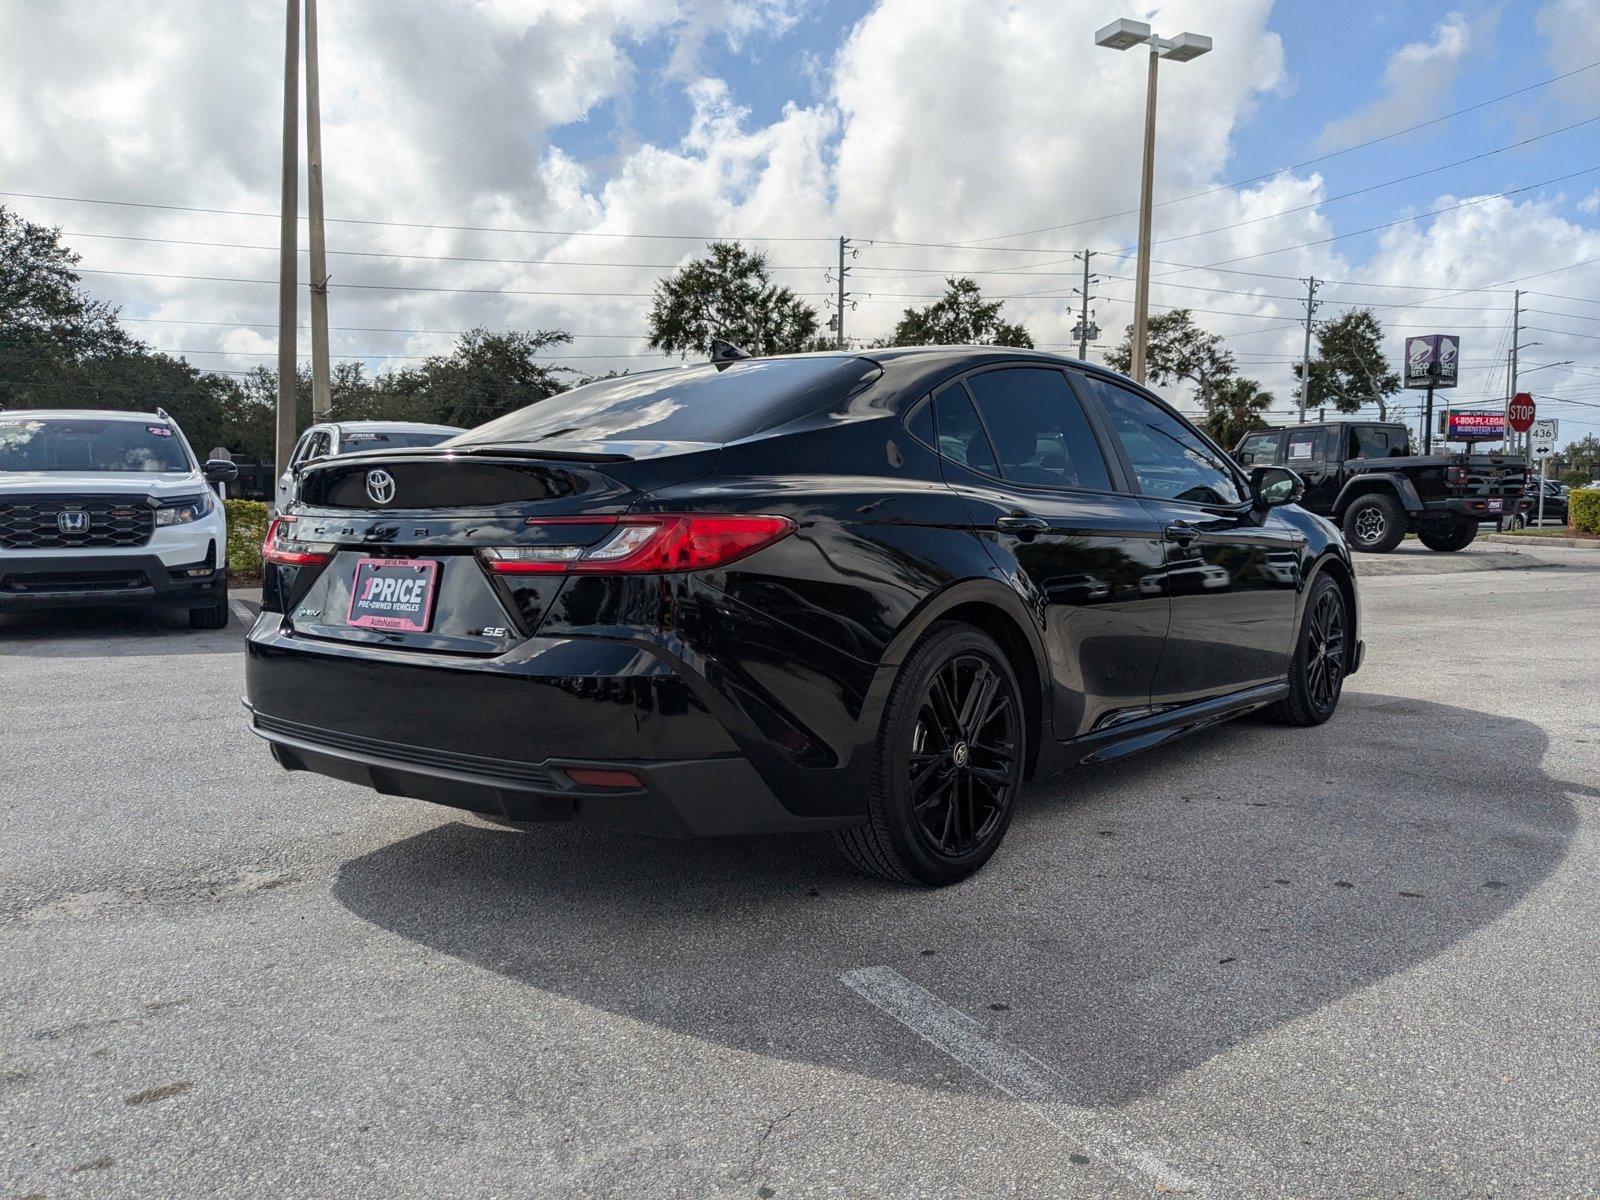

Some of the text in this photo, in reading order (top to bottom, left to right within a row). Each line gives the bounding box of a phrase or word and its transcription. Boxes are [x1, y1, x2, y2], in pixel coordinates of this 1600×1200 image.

[1410, 362, 1430, 370] TACO
[1441, 362, 1455, 370] TACO
[1411, 370, 1429, 378] BELL
[1441, 369, 1454, 377] BELL
[1510, 405, 1534, 420] STOP
[1455, 416, 1504, 425] 1-800-FL-LEGA
[1533, 429, 1552, 438] 436
[314, 526, 479, 538] CAMRY
[358, 600, 420, 612] PRE-OWNED VEHICLES
[370, 618, 401, 628] AutoNation
[482, 627, 506, 637] SE
